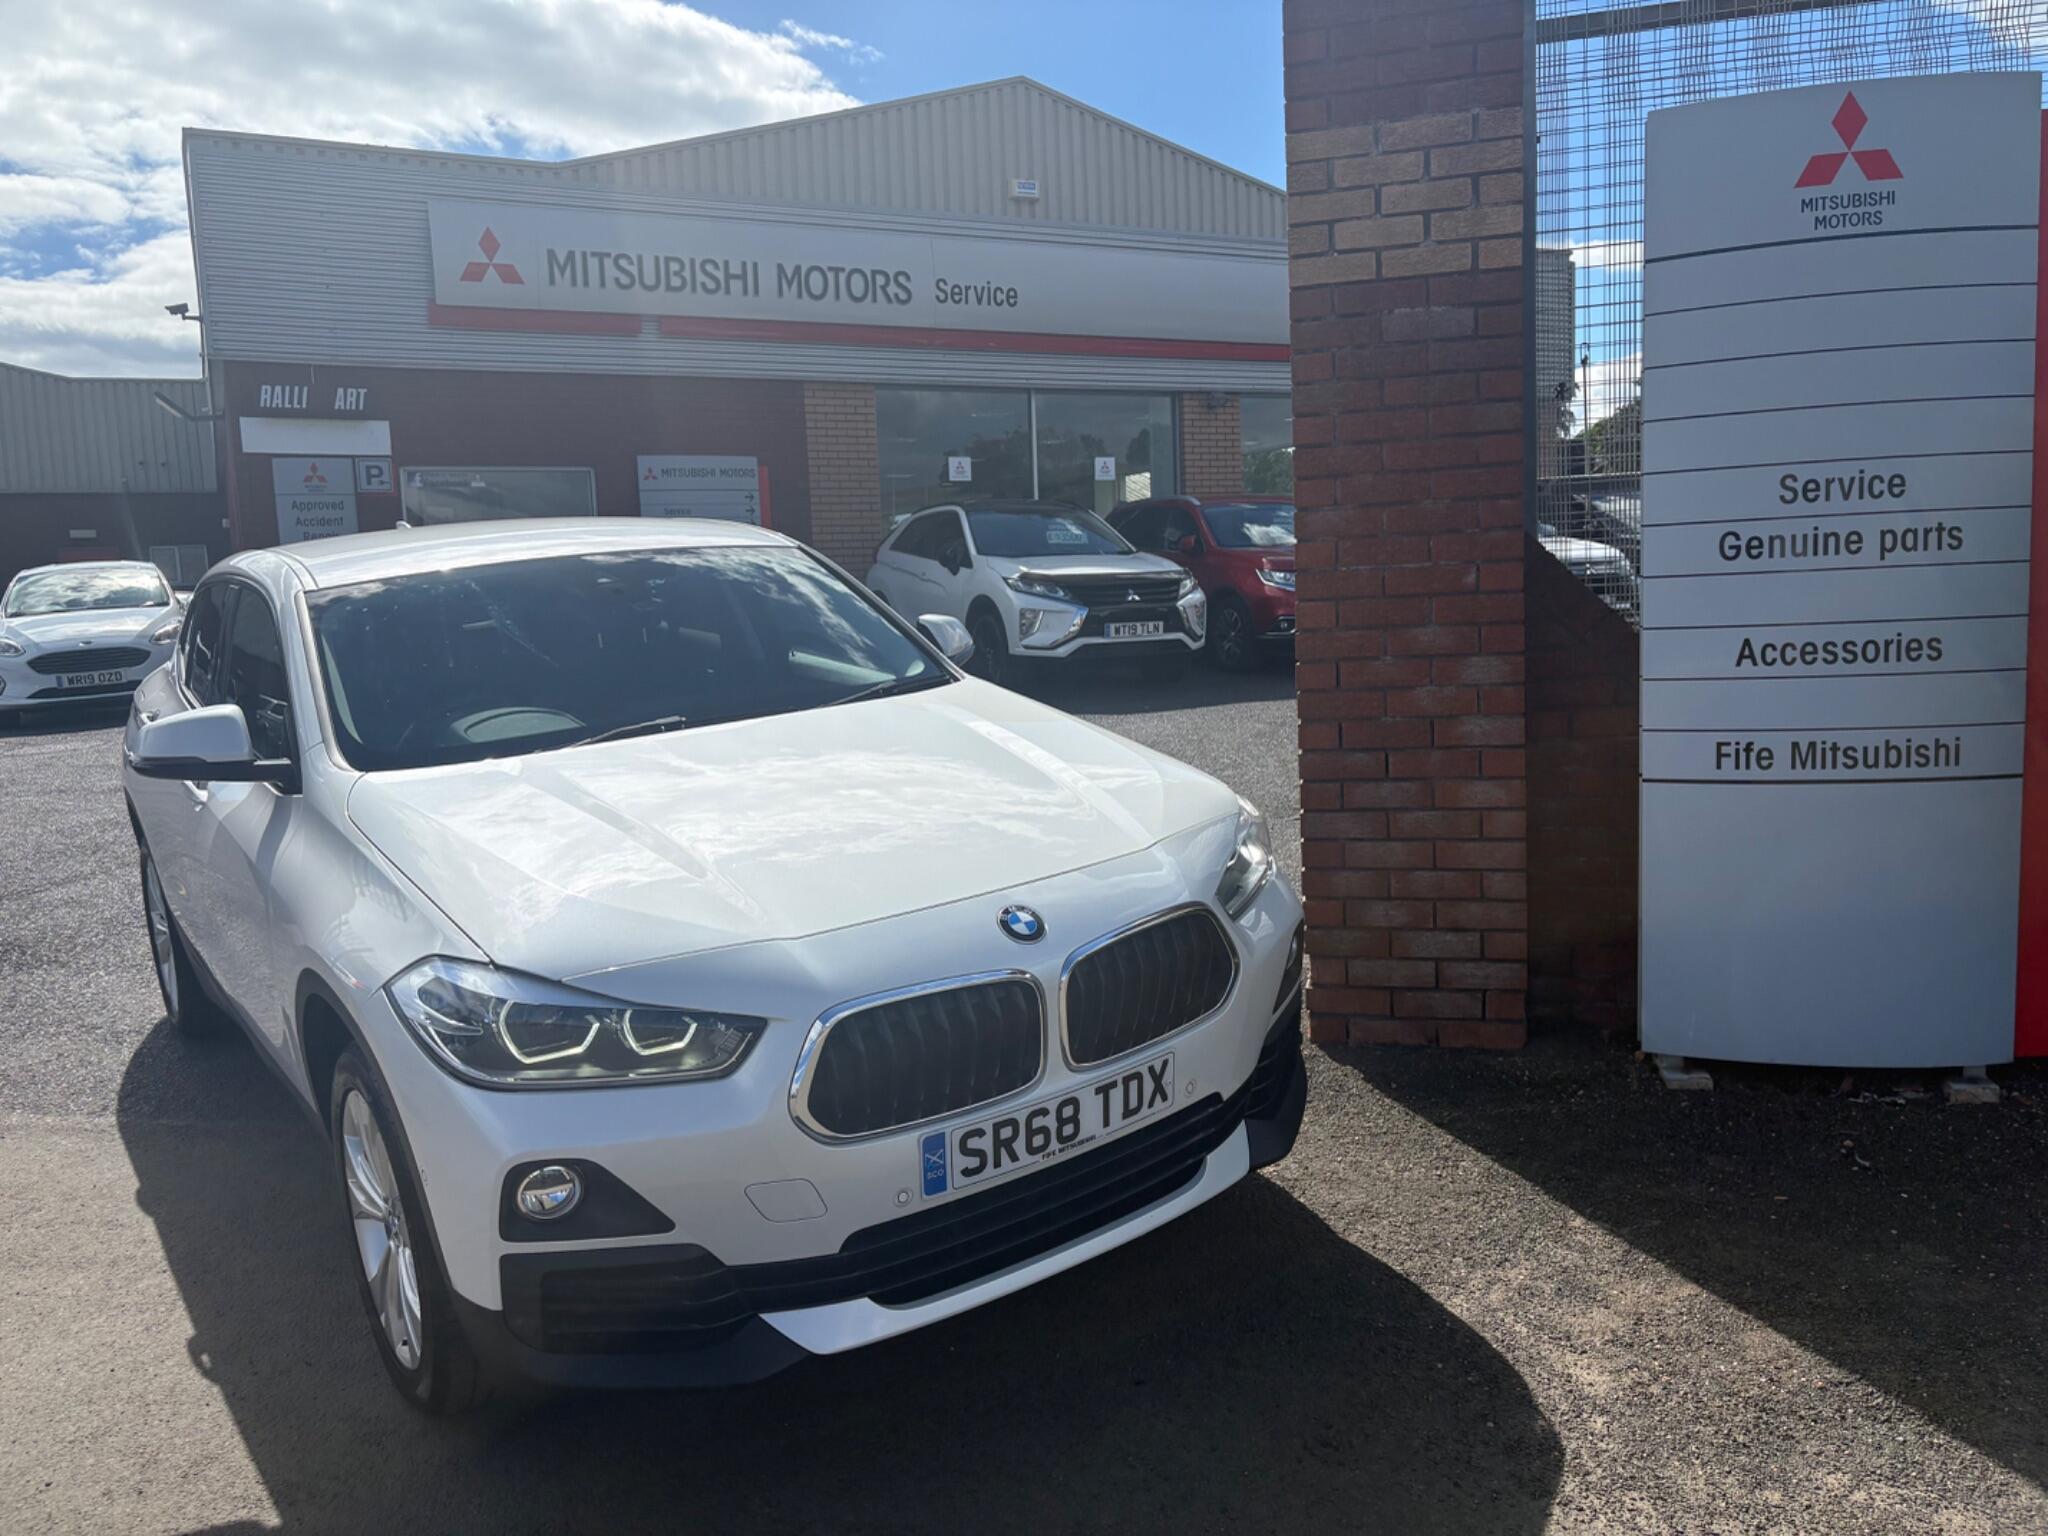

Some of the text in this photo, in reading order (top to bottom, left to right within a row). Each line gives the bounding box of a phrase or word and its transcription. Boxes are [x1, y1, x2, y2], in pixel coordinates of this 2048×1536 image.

[1800, 190, 1895, 213] MITSUBISHI
[1814, 210, 1883, 231] MOTORS
[546, 248, 1019, 308] MITSUBISHI MOTORS Service
[259, 384, 368, 411] RALLI ART
[364, 464, 384, 486] P
[661, 467, 756, 479] MITSUBISHI MOTORS
[1778, 469, 1907, 505] Service
[291, 500, 345, 513] Approved
[296, 517, 344, 528] Accident
[1718, 521, 1963, 562] Genuine parts
[1735, 632, 1944, 668] Accessories
[66, 673, 96, 686] WR19
[1715, 736, 1962, 771] Fife Mitsubishi
[958, 1058, 1170, 1178] SR68 TDX
[927, 1167, 945, 1181] SCO
